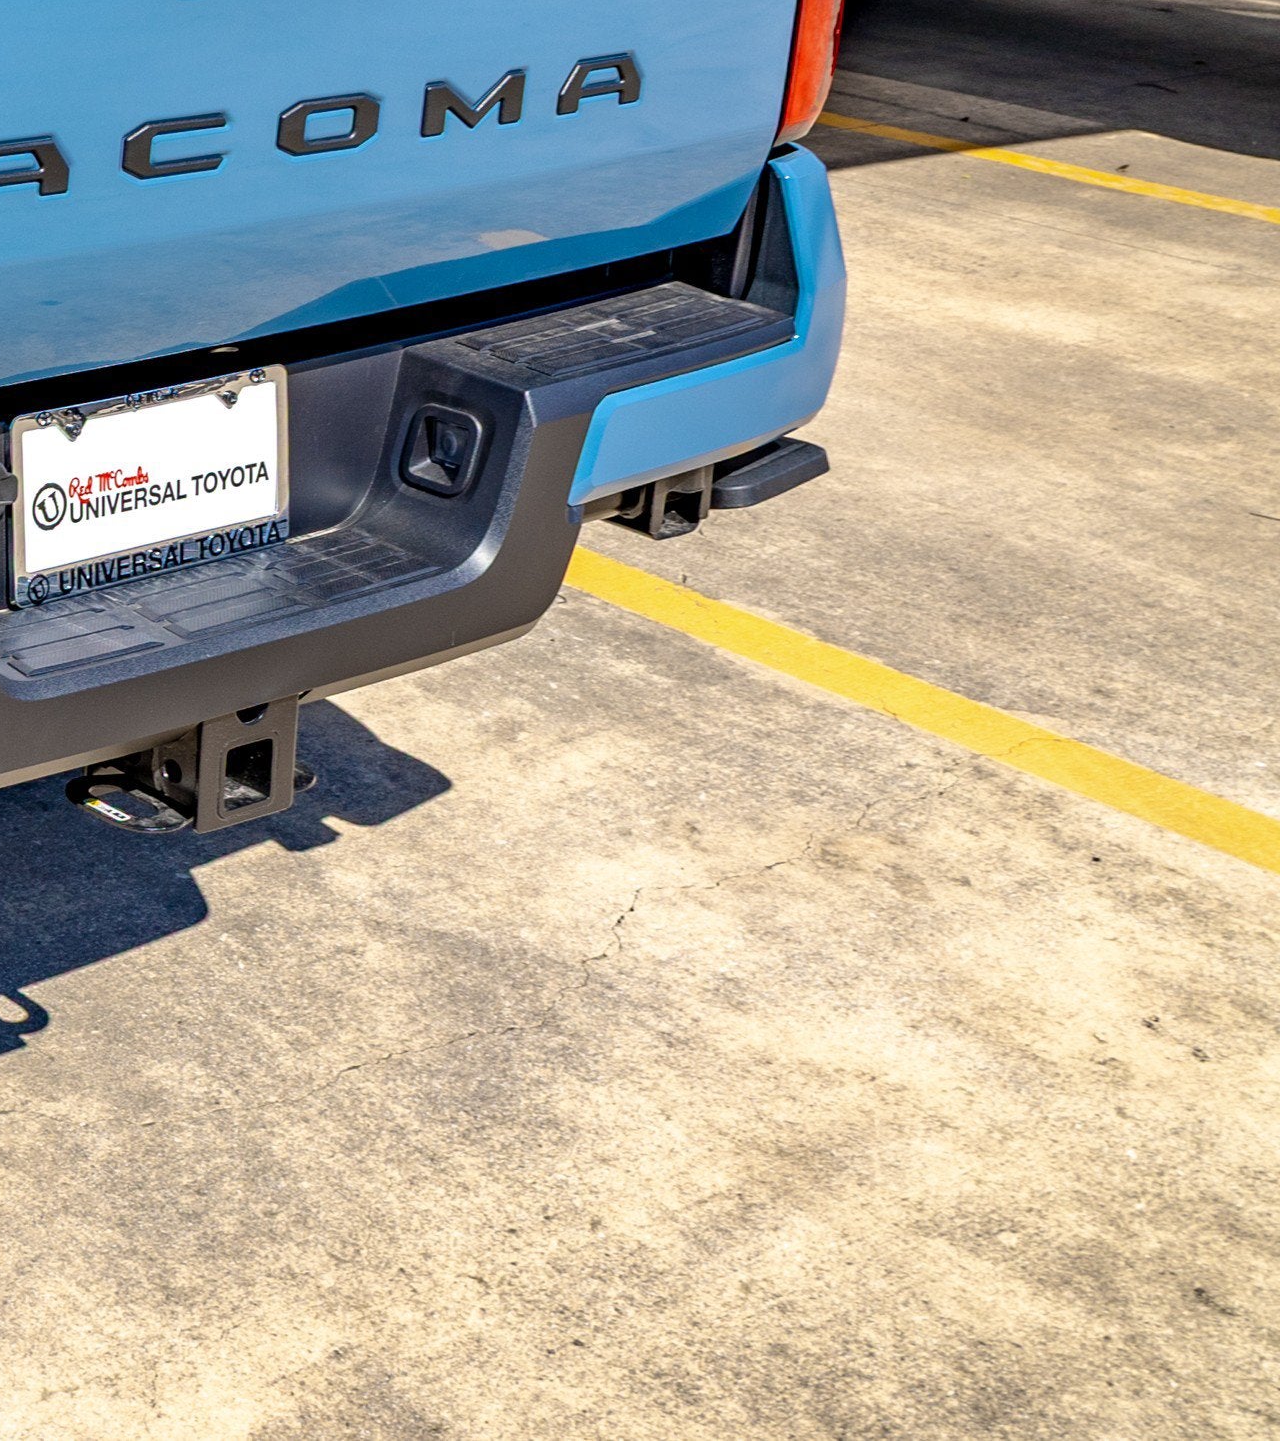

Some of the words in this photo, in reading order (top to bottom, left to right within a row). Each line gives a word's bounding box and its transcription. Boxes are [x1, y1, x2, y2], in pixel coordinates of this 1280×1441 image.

[69, 475, 94, 504] Red
[96, 467, 149, 494] McCombs
[69, 480, 187, 524] UNIVERSAL
[191, 461, 269, 496] TOYOTA
[59, 541, 194, 594] UNIVERSAL
[195, 520, 282, 558] TOYOTA
